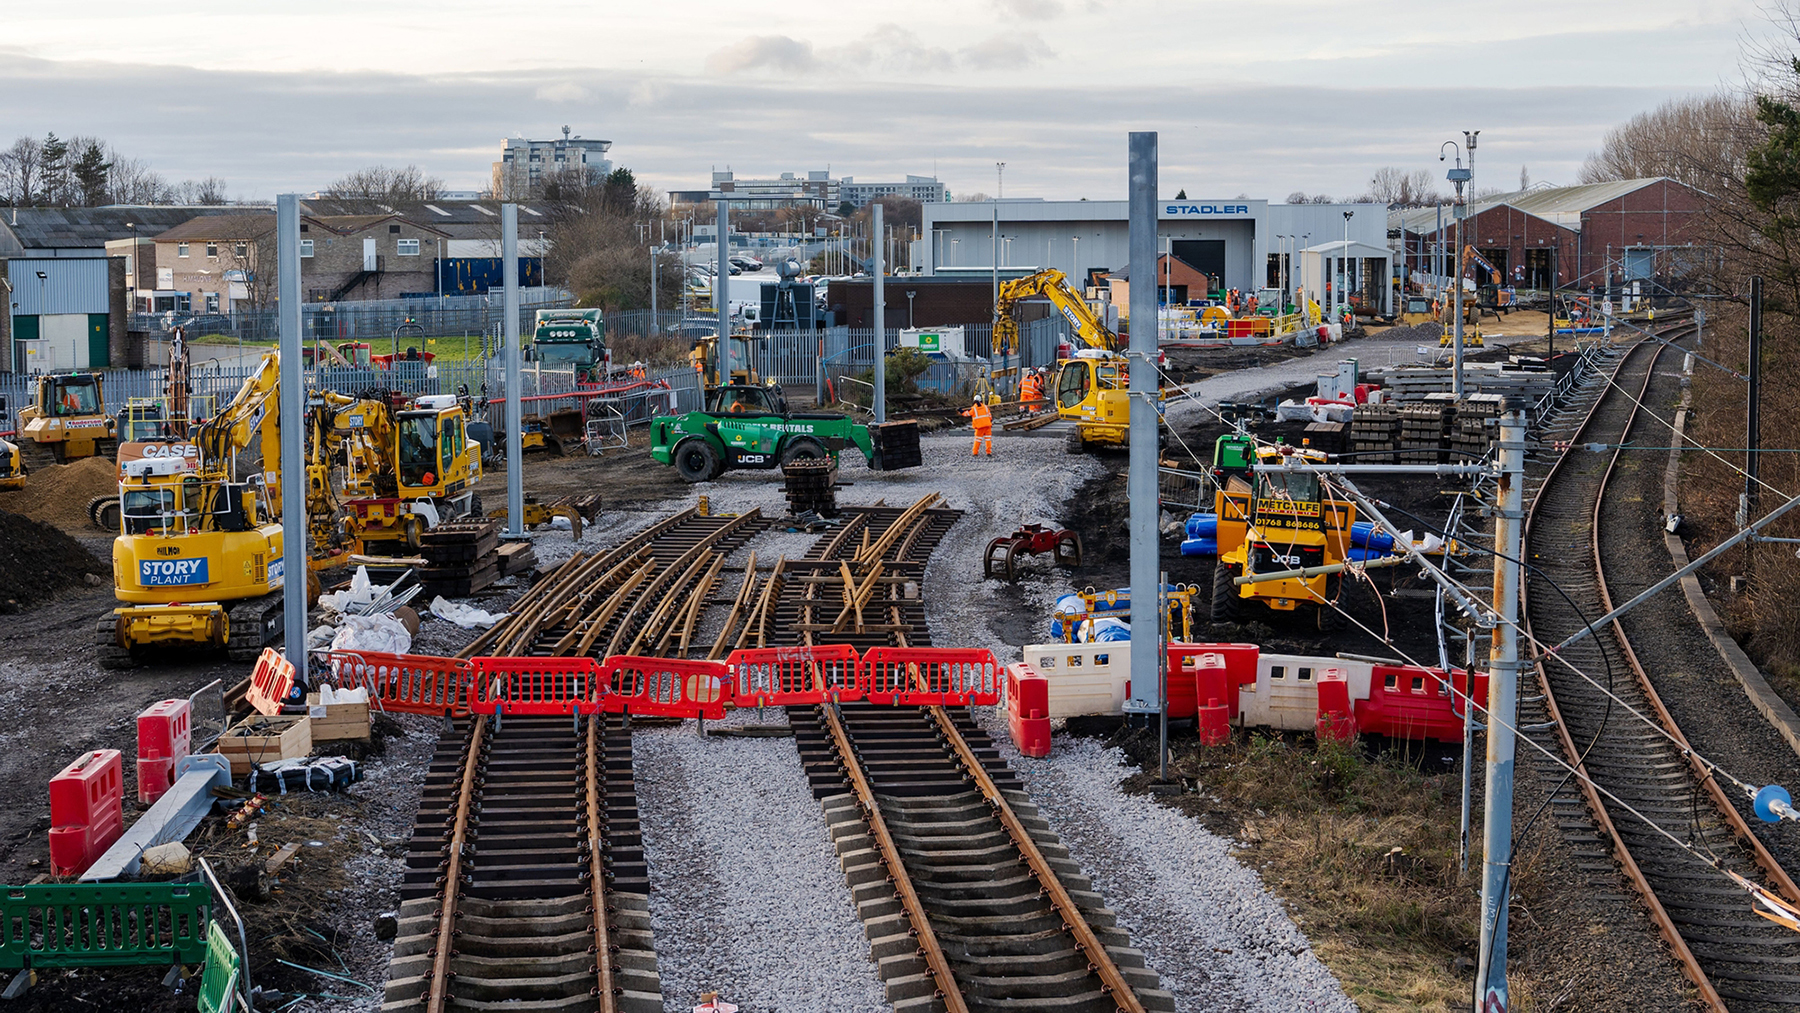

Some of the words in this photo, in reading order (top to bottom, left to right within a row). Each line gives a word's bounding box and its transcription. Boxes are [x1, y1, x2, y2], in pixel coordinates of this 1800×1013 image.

[1166, 205, 1248, 214] STADLER
[1063, 306, 1082, 329] STORY
[350, 416, 363, 426] STORY
[770, 423, 814, 433] RENTALS
[142, 445, 197, 458] CASE
[738, 455, 764, 463] JCB
[1259, 501, 1319, 512] METCALFE
[1256, 518, 1282, 526] 01768
[1272, 554, 1300, 564] JCB
[143, 560, 201, 575] STORY
[151, 575, 190, 584] PLANT
